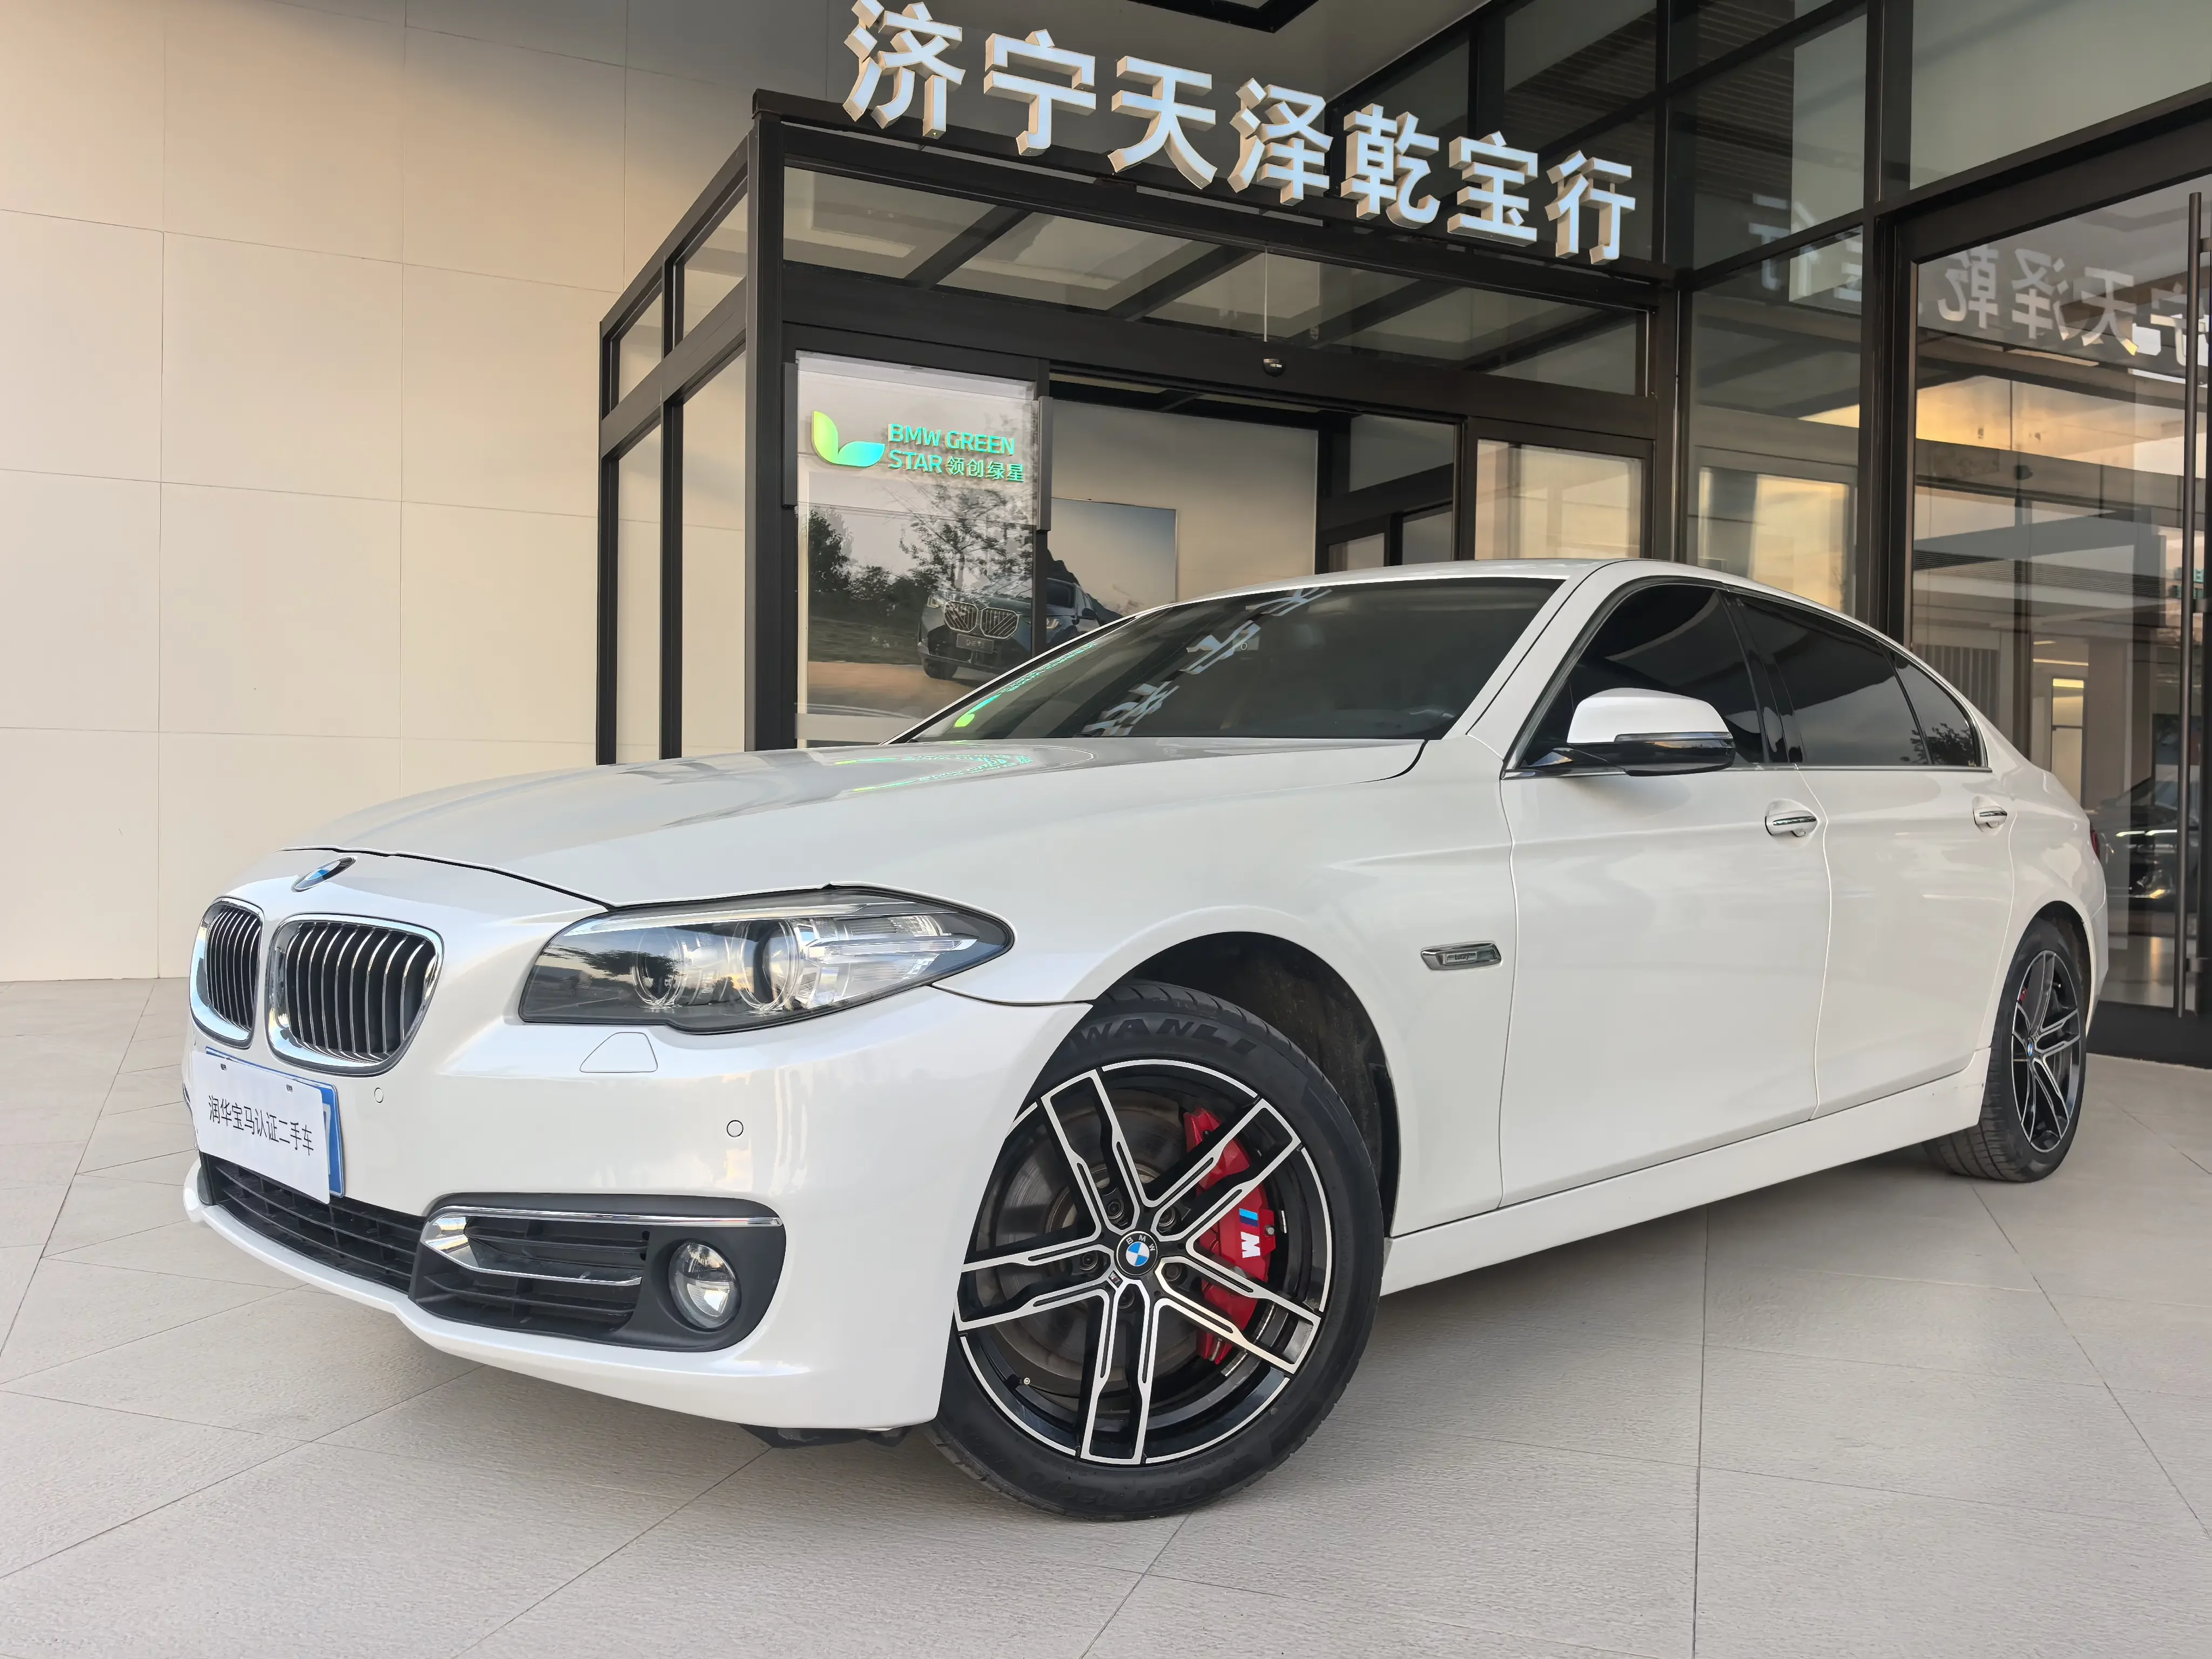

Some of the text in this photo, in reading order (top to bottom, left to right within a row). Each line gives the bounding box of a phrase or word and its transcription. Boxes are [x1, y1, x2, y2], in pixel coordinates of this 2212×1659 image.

[843, 0, 1635, 265] 济宁天泽乾宝行
[888, 423, 1015, 455] BMW GREEN
[888, 450, 1025, 483] STAR 领创绿星
[1068, 1019, 1257, 1055] WANLI
[208, 1095, 314, 1156] 润华宝马认证二手车
[1126, 1235, 1156, 1251] BMW
